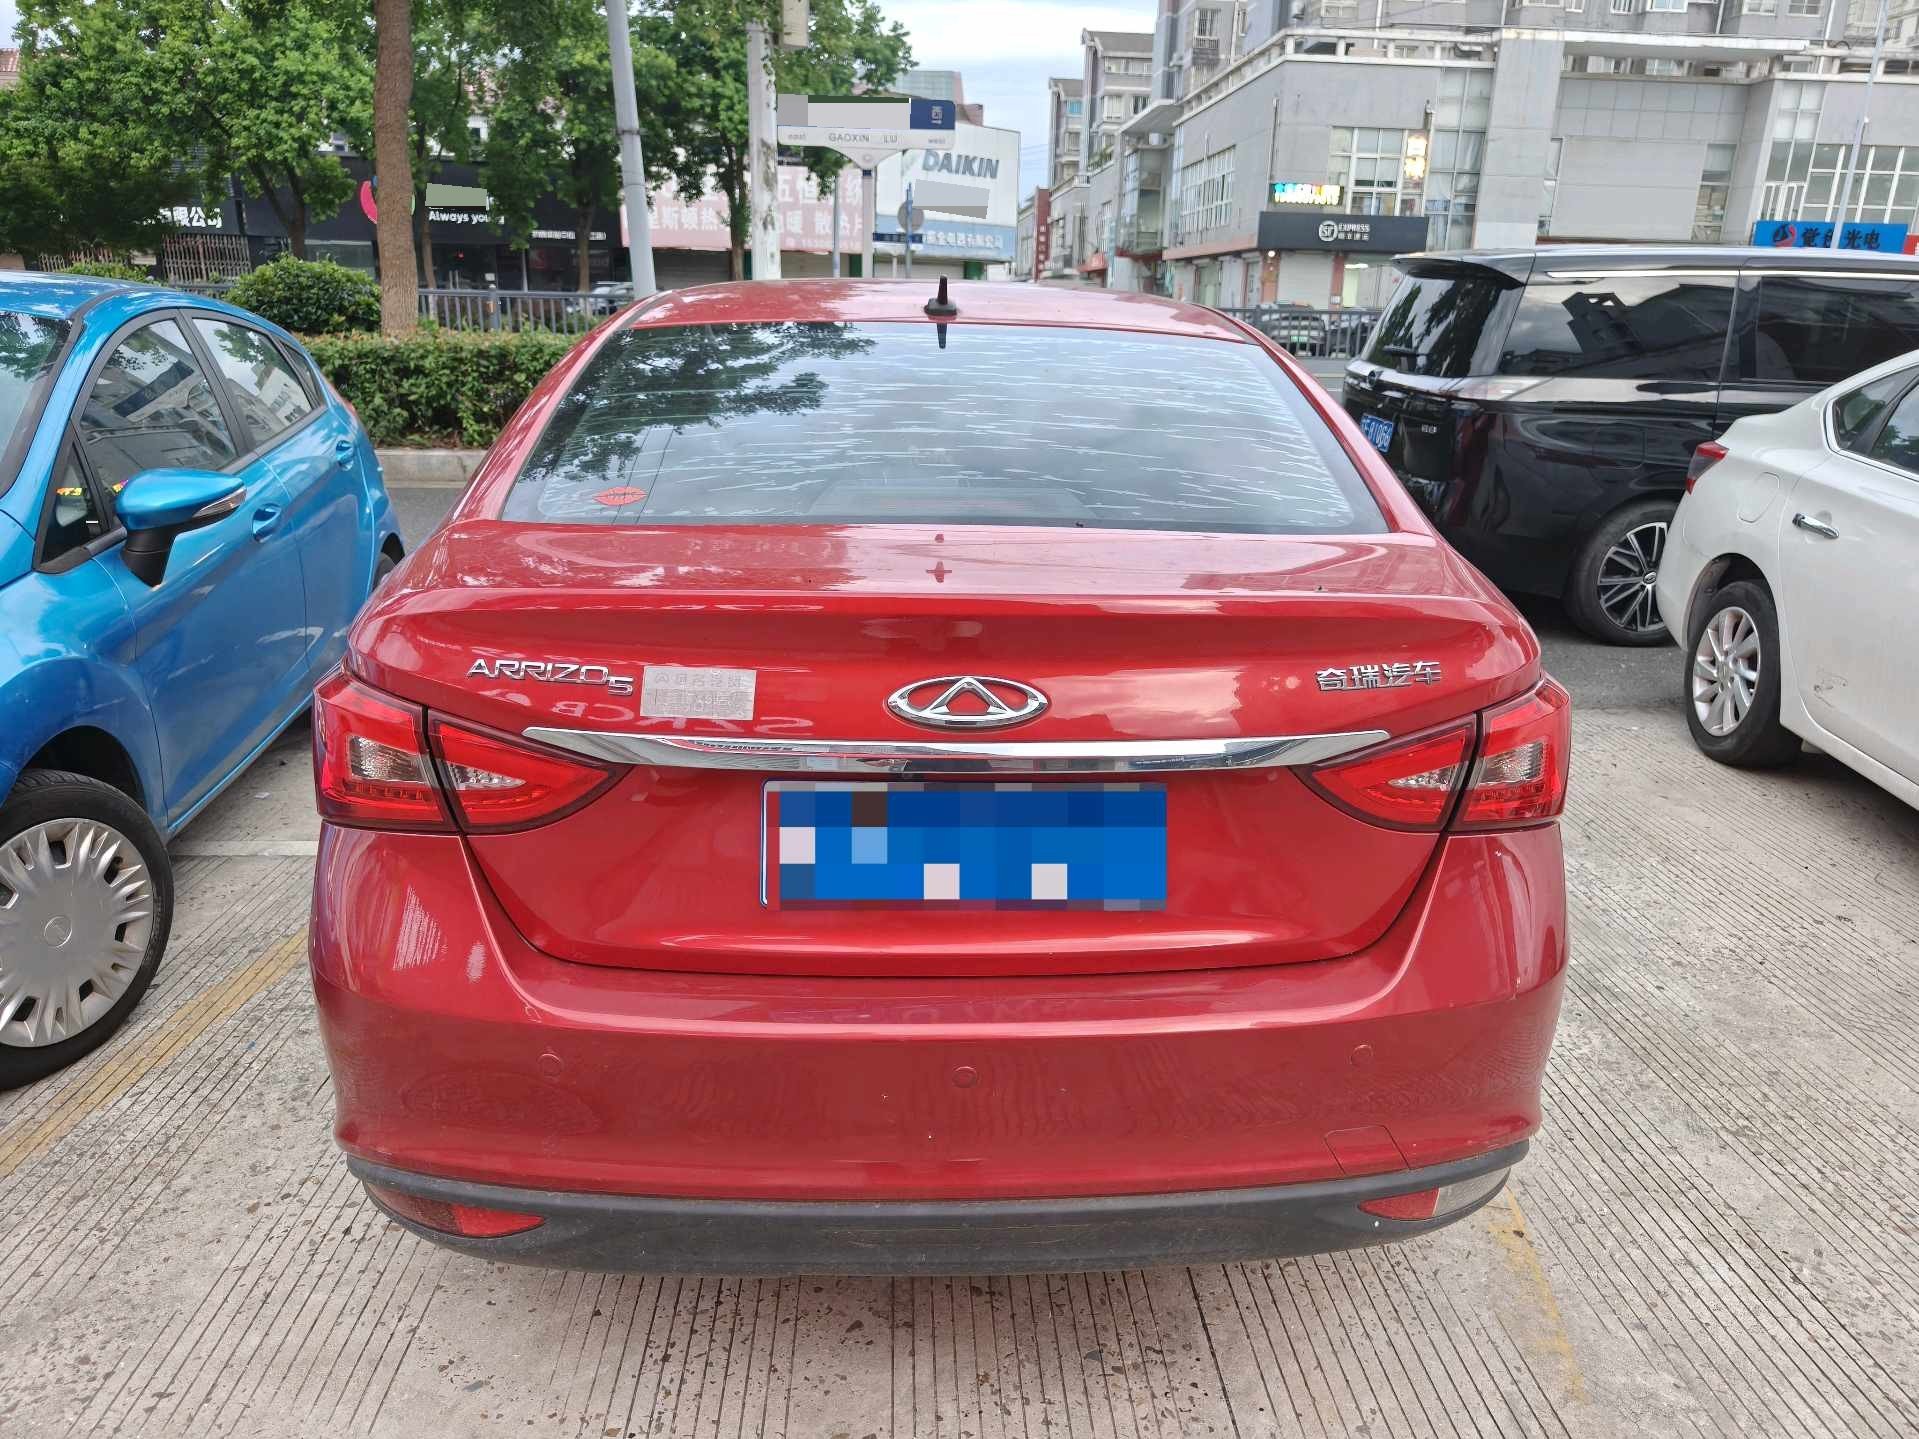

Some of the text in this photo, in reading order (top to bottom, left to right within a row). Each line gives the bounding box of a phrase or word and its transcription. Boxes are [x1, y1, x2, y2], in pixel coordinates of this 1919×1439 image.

[828, 133, 870, 143] GAOXIN
[922, 150, 1000, 180] DAIKIN
[428, 210, 469, 224] Always
[467, 658, 609, 685] ARRIZO
[607, 677, 634, 695] 5
[1315, 661, 1442, 692] 奇瑞汽车
